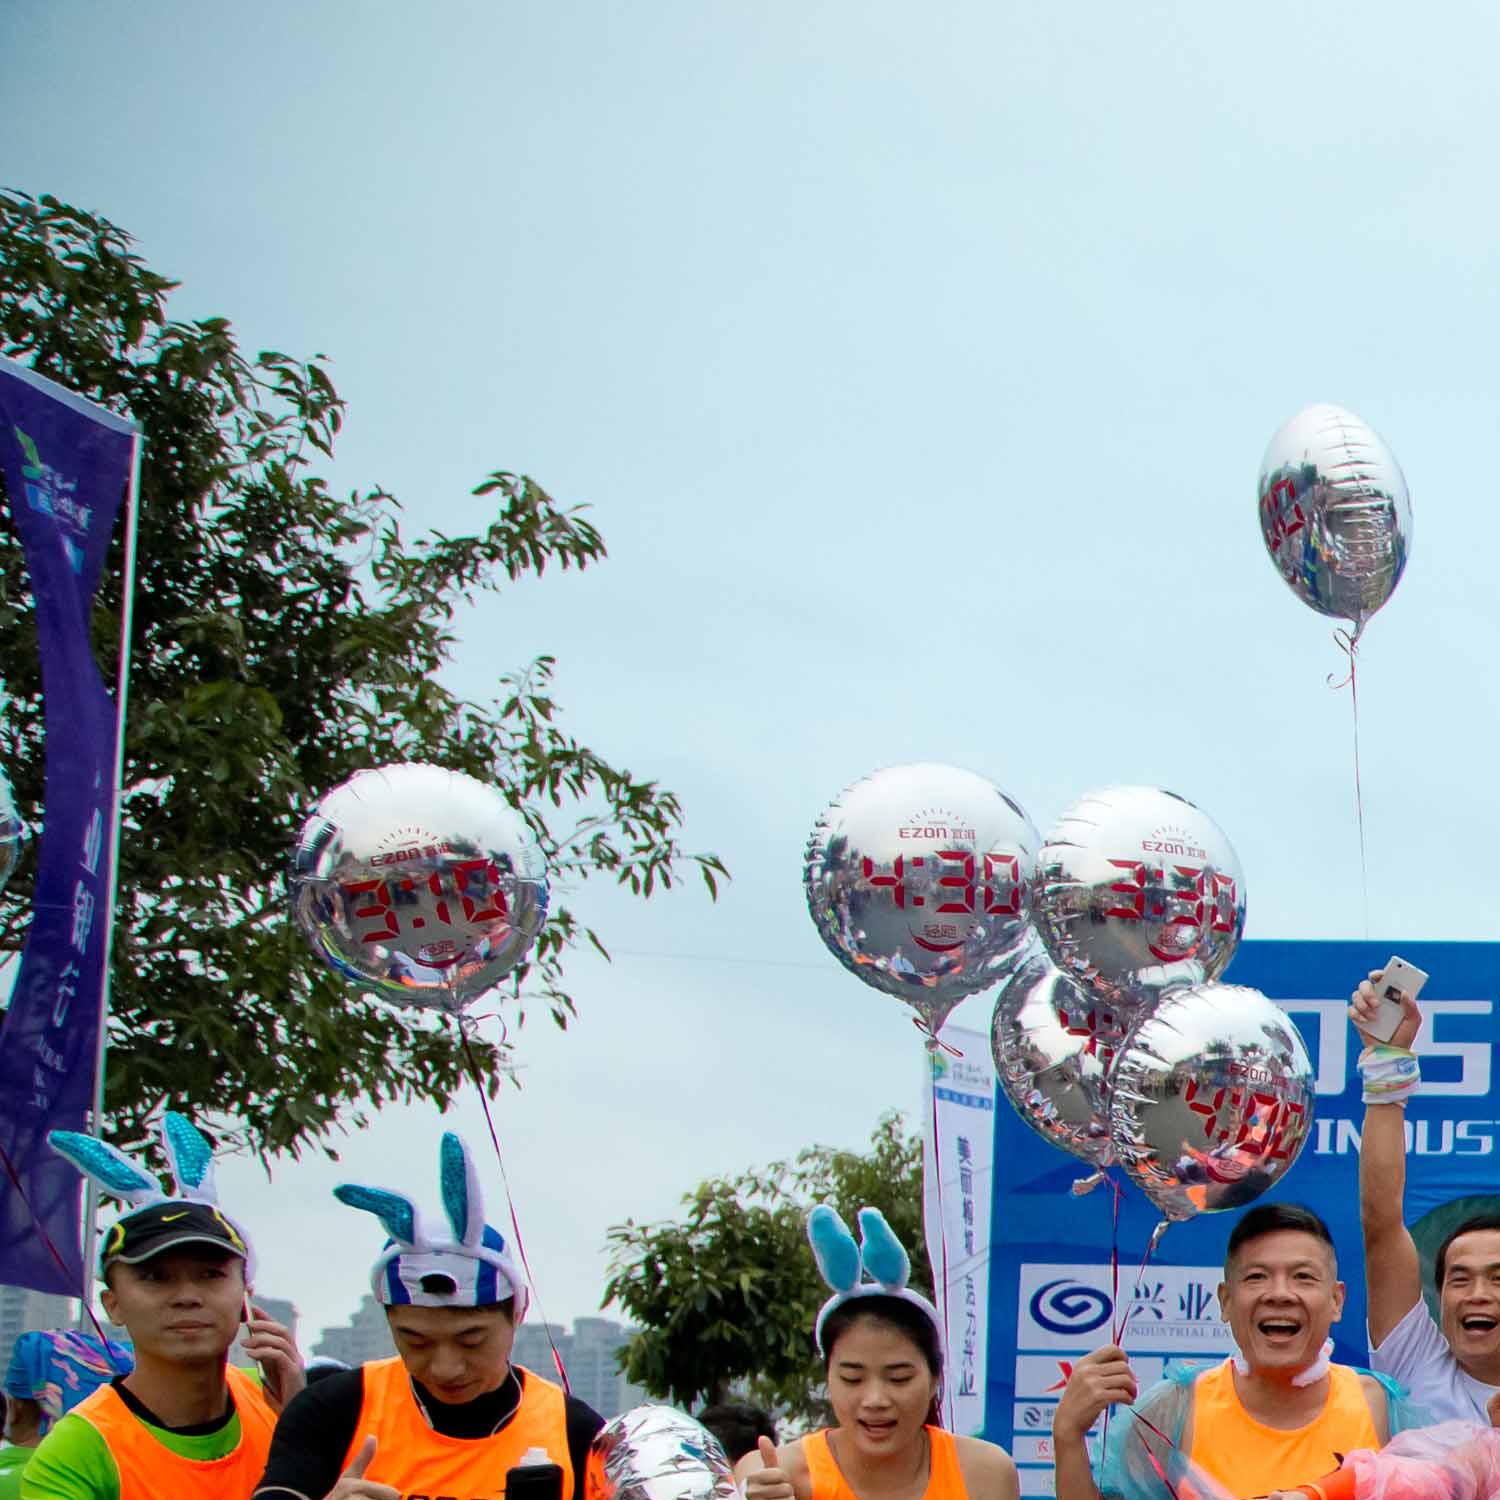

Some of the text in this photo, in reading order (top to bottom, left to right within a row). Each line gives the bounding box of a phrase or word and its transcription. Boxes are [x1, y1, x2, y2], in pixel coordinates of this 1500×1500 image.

[899, 827, 949, 840] EZON
[370, 846, 419, 868] EZON
[1141, 840, 1184, 856] EZON
[863, 850, 1021, 916] 4:30
[1105, 858, 1237, 933] 3:30
[1230, 1062, 1267, 1084] EZON
[1130, 1281, 1219, 1323] 兴业
